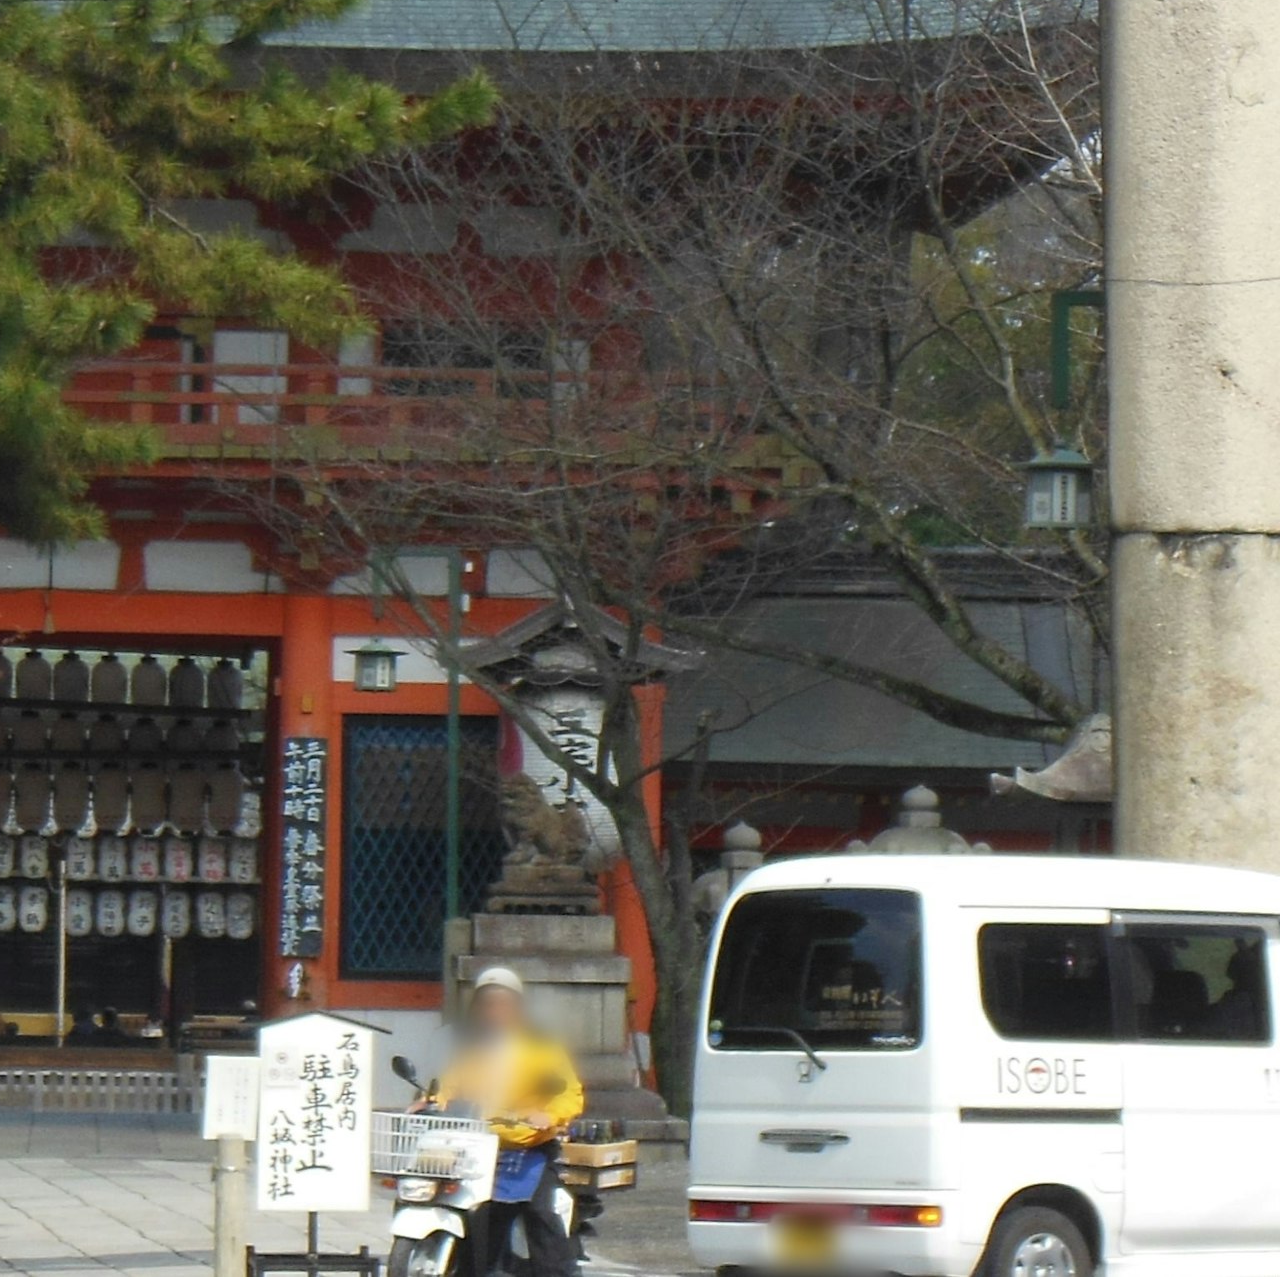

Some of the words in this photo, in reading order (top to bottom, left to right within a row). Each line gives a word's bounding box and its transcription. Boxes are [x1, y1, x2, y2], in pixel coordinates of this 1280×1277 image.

[302, 741, 326, 822] 三月二十日
[295, 1054, 334, 1173] 駐車禁止
[335, 1033, 360, 1132] 石鳥居内
[998, 1057, 1087, 1094] ISOBE
[267, 1109, 297, 1201] 八坂神社
